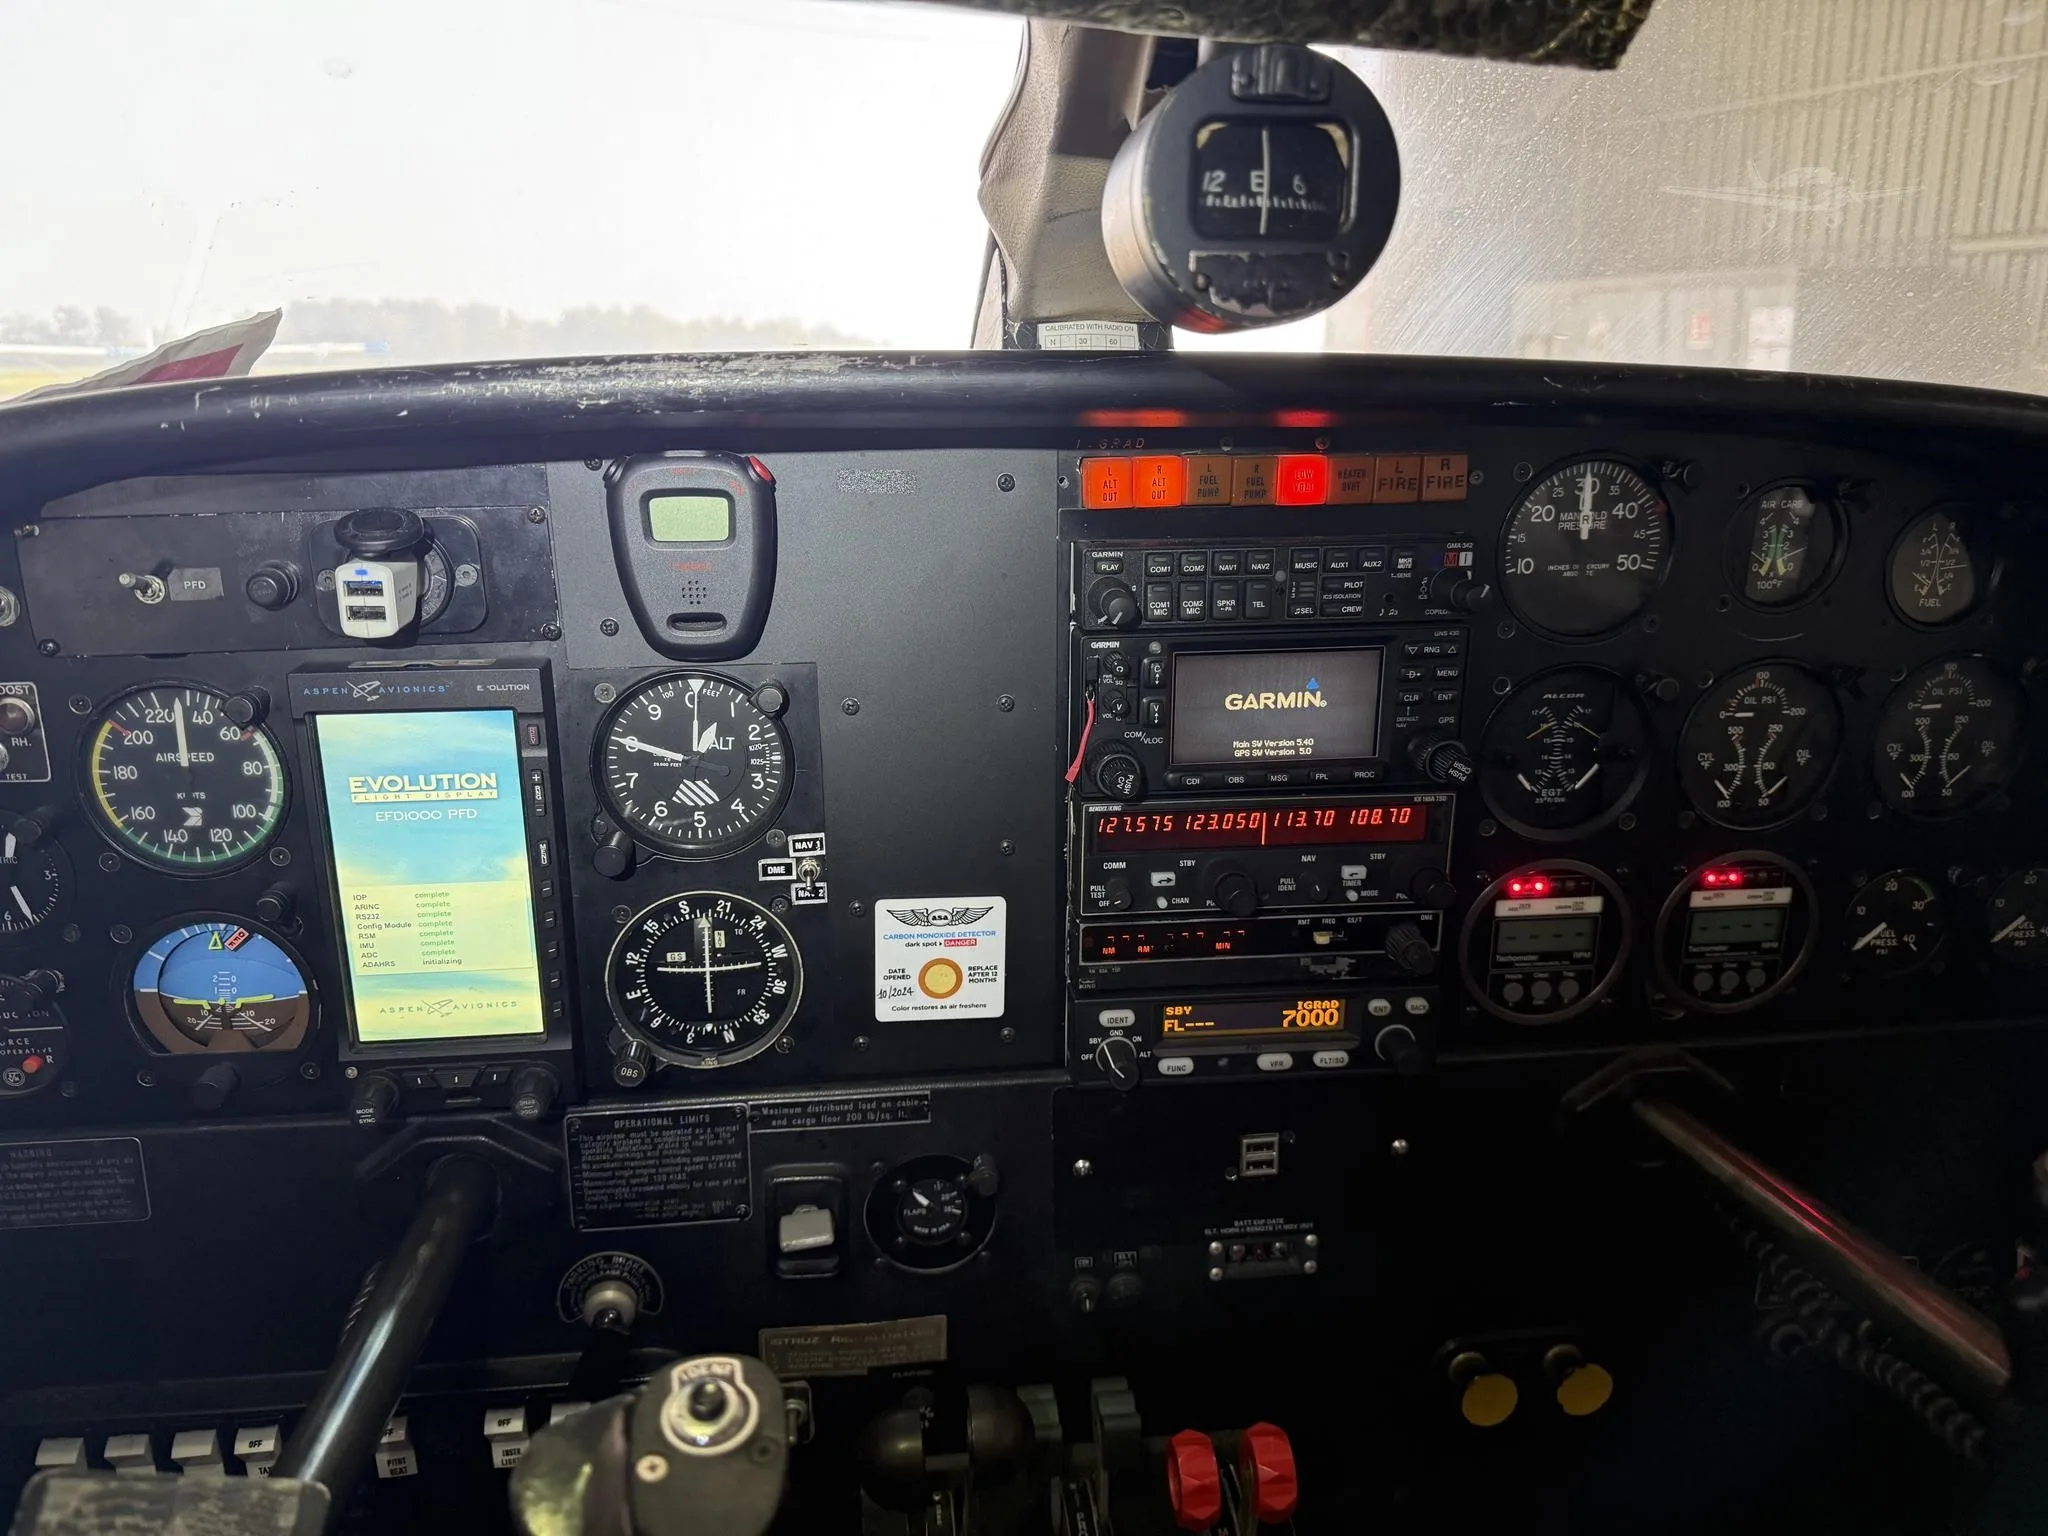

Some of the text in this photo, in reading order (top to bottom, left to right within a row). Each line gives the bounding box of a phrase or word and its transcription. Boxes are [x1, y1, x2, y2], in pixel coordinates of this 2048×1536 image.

[1202, 170, 1227, 193] 12
[1292, 171, 1307, 195] 6
[1045, 323, 1084, 332] CALIBRATED
[1086, 322, 1103, 331] WITH
[1104, 323, 1123, 332] RADIO
[1441, 458, 1450, 471] R
[1103, 479, 1118, 489] ALT
[1152, 477, 1166, 487] ALT
[1200, 475, 1217, 485] FUEL
[1378, 478, 1417, 492] FIRE
[1426, 475, 1464, 489] FIRE
[1102, 491, 1118, 502] OUT
[1151, 489, 1166, 500] OUT
[1197, 488, 1219, 498] PUMP
[1530, 504, 1556, 522] 20
[1612, 501, 1639, 519] 40
[1101, 563, 1119, 571] PLAY
[1295, 561, 1317, 569] MUSIC
[1517, 557, 1534, 575] 10
[1616, 553, 1641, 572] 50
[184, 580, 206, 590] PFD
[1183, 600, 1204, 608] COM2
[1918, 598, 1942, 608] FUEL
[1091, 641, 1120, 649] GARMIN
[1424, 646, 1440, 654] RNG
[1436, 669, 1458, 677] MENU
[304, 685, 446, 696] ASPEN AVIONICS
[702, 688, 721, 699] FEET
[1224, 691, 1321, 711] GARMIN
[1437, 693, 1453, 701] ENT
[1744, 695, 1776, 705] OIL PSI
[1975, 699, 1992, 708] 200
[144, 708, 175, 723] 220
[192, 710, 214, 725] 40
[648, 704, 662, 720] 9
[1789, 707, 1806, 717] 200
[1914, 717, 1931, 726] 500
[220, 727, 241, 741] 60
[747, 724, 762, 742] 2
[1727, 726, 1744, 735] 500
[1768, 724, 1784, 733] 250
[123, 730, 154, 746] 200
[113, 765, 138, 781] 180
[241, 761, 263, 776] 80
[5, 772, 28, 781] TEST
[1228, 775, 1244, 784] OBS
[1270, 774, 1288, 783] MSG
[1354, 770, 1375, 779] PROC
[1448, 768, 1468, 783] PUSH
[348, 772, 497, 793] EVOLUTION
[625, 772, 639, 789] 7
[750, 773, 765, 790] 3
[1186, 776, 1200, 786] CDI
[353, 790, 496, 801] FLIGHT DISPLAY
[1541, 789, 1563, 797] EGT
[1901, 790, 1915, 798] 100
[1941, 788, 1952, 797] 50
[654, 800, 669, 818] 6
[730, 797, 746, 813] 4
[130, 806, 156, 821] 160
[232, 803, 256, 819] 100
[375, 808, 478, 822] EFD1000 PFD
[693, 811, 707, 828] 5
[1185, 812, 1261, 831] 123.050
[1273, 807, 1412, 827] 113.70 108.70
[163, 828, 189, 843] 140
[208, 827, 233, 843] 120
[1301, 854, 1317, 863] NAV
[1369, 852, 1387, 860] STBY
[1103, 861, 1127, 870] COMM
[1179, 859, 1196, 867] STBY
[44, 869, 52, 881] 3
[767, 864, 786, 875] DME
[2024, 875, 2038, 885] 20
[1884, 881, 1898, 891] 20
[414, 891, 450, 900] complete
[354, 900, 451, 911] ARINC complete
[678, 900, 690, 914] S
[716, 899, 732, 913] 21
[4, 910, 13, 922] 6
[356, 910, 452, 920] RS232 complete
[357, 919, 453, 931] Config Module complete
[642, 918, 660, 935] 15
[749, 914, 768, 931] 24
[358, 929, 454, 940] RSM complete
[883, 930, 996, 941] CARBON MONOXIDE DETECTOR
[1903, 934, 1916, 944] 40
[420, 938, 455, 948] complete
[922, 941, 937, 949] spot
[945, 939, 976, 947] DANGER
[361, 948, 456, 959] ADC complete
[770, 943, 789, 960] W
[625, 950, 640, 966] 12
[772, 978, 788, 995] 30
[625, 988, 643, 1001] E
[877, 985, 915, 1000] 10/2024
[379, 1000, 518, 1015] ASPEN AVIONICS
[1165, 1005, 1192, 1016] SBY
[1297, 1000, 1340, 1011] IGRAD
[187, 1016, 197, 1025] 20
[752, 1008, 771, 1025] 33
[1282, 1008, 1339, 1028] 7000
[722, 1029, 737, 1044] N
[46, 1054, 54, 1064] R
[620, 1066, 639, 1078] OBS
[614, 1113, 711, 1129] OPERATIONAL LIMITS
[497, 1418, 512, 1427] OFF
[248, 1439, 263, 1449] OFF
